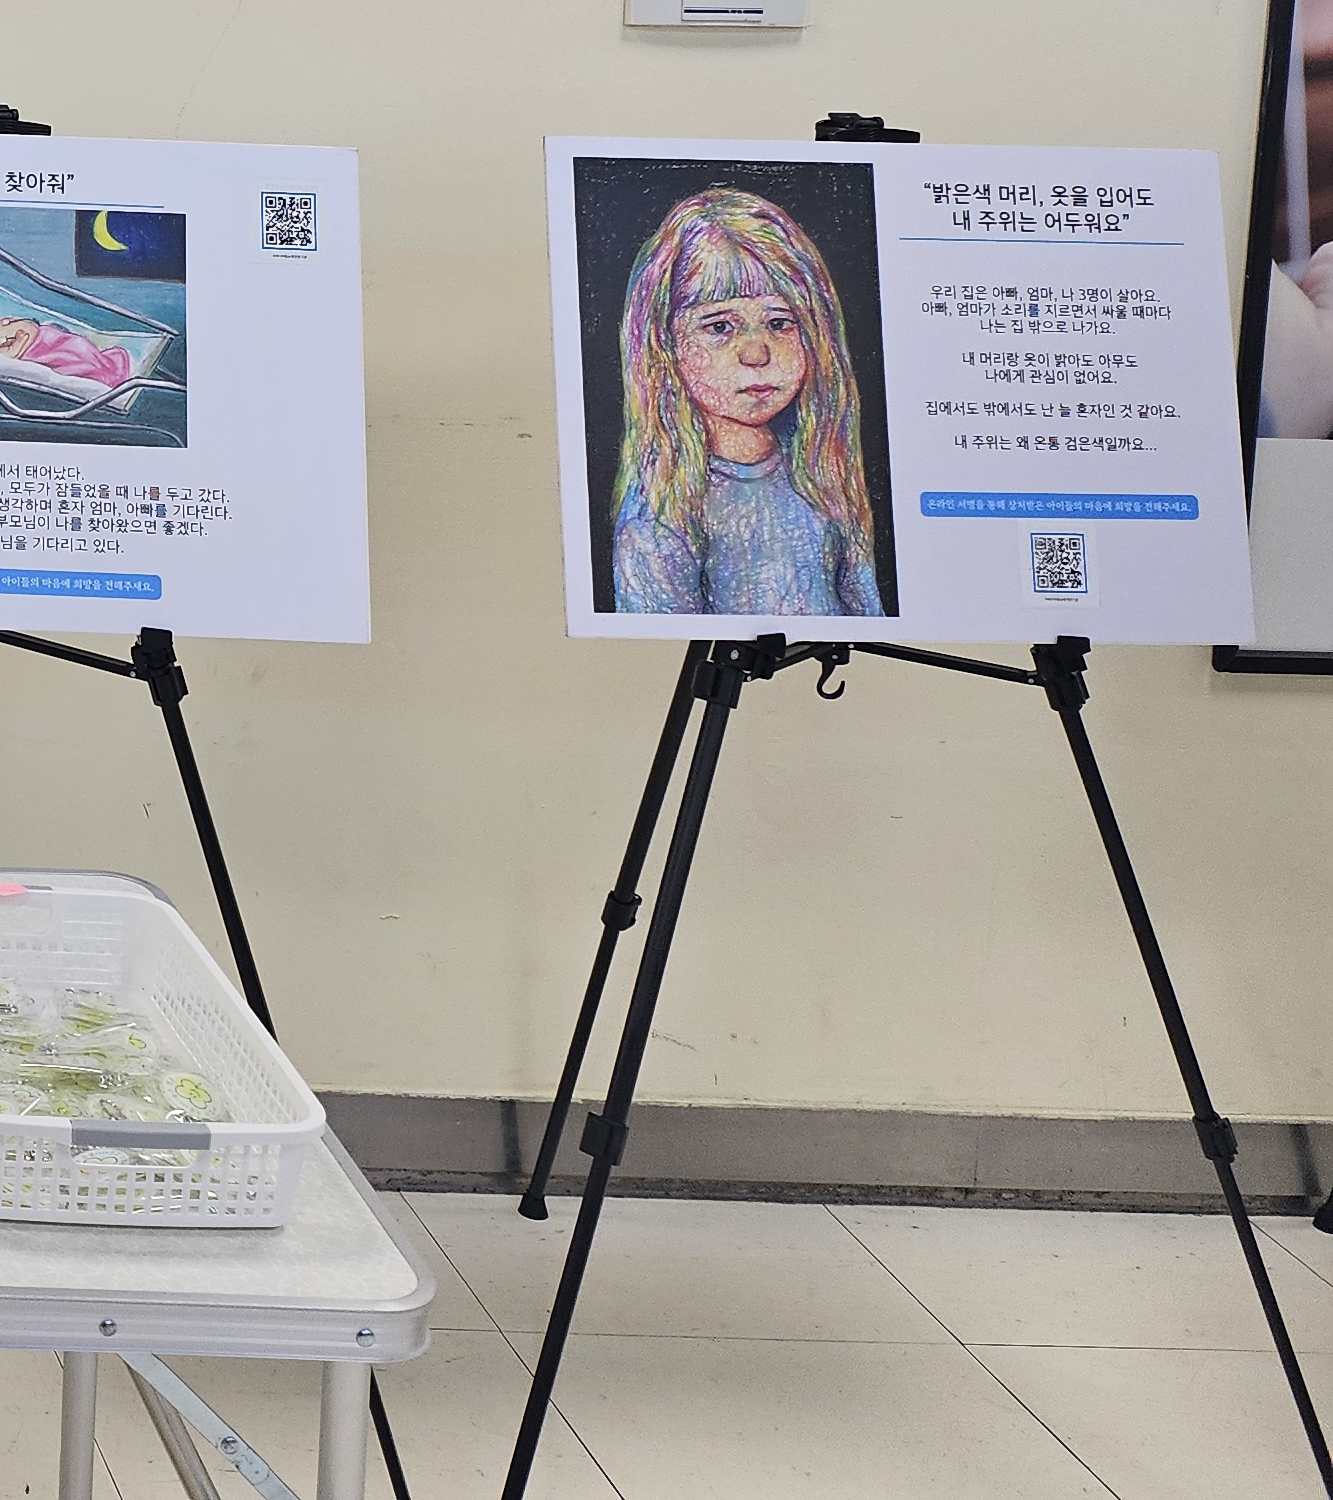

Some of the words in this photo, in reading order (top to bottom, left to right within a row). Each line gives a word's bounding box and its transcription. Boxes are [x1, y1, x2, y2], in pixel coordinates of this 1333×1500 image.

[4, 171, 75, 195] 찾아줘”
[923, 182, 991, 206] “밝은색
[998, 184, 1044, 208] 머리,
[1050, 185, 1089, 208] 옷을
[1096, 186, 1155, 209] 입어도
[952, 209, 971, 232] 내
[977, 210, 1038, 233] 주위는
[1044, 211, 1130, 234] 어두워요”
[930, 285, 957, 300] 우리
[961, 285, 988, 301] 집은
[992, 285, 1023, 302] 아빠,
[1026, 286, 1058, 303] 엄마,
[1061, 287, 1075, 302] 나
[1078, 287, 1113, 303] 3명이
[1116, 288, 1161, 304] 살아요.
[925, 400, 980, 417] 집에서도
[983, 401, 1038, 417] 밖에서도
[1040, 402, 1055, 418] 난
[1058, 402, 1072, 418] 늘
[1075, 402, 1116, 419] 혼자인
[1119, 403, 1133, 419] 것
[1136, 403, 1181, 420] 같아요.
[954, 434, 968, 450] 내
[971, 435, 1012, 451] 주위는
[1016, 435, 1030, 451] 왜
[1033, 435, 1061, 451] 온통
[1064, 436, 1158, 452] 검은색일까요...
[25, 464, 85, 482] 태어났다.
[55, 516, 83, 532] 나를
[87, 517, 157, 535] 찾아왔으면
[161, 520, 208, 537] 좋겠다.
[32, 536, 88, 553] 기다리고
[92, 538, 125, 555] 있다.
